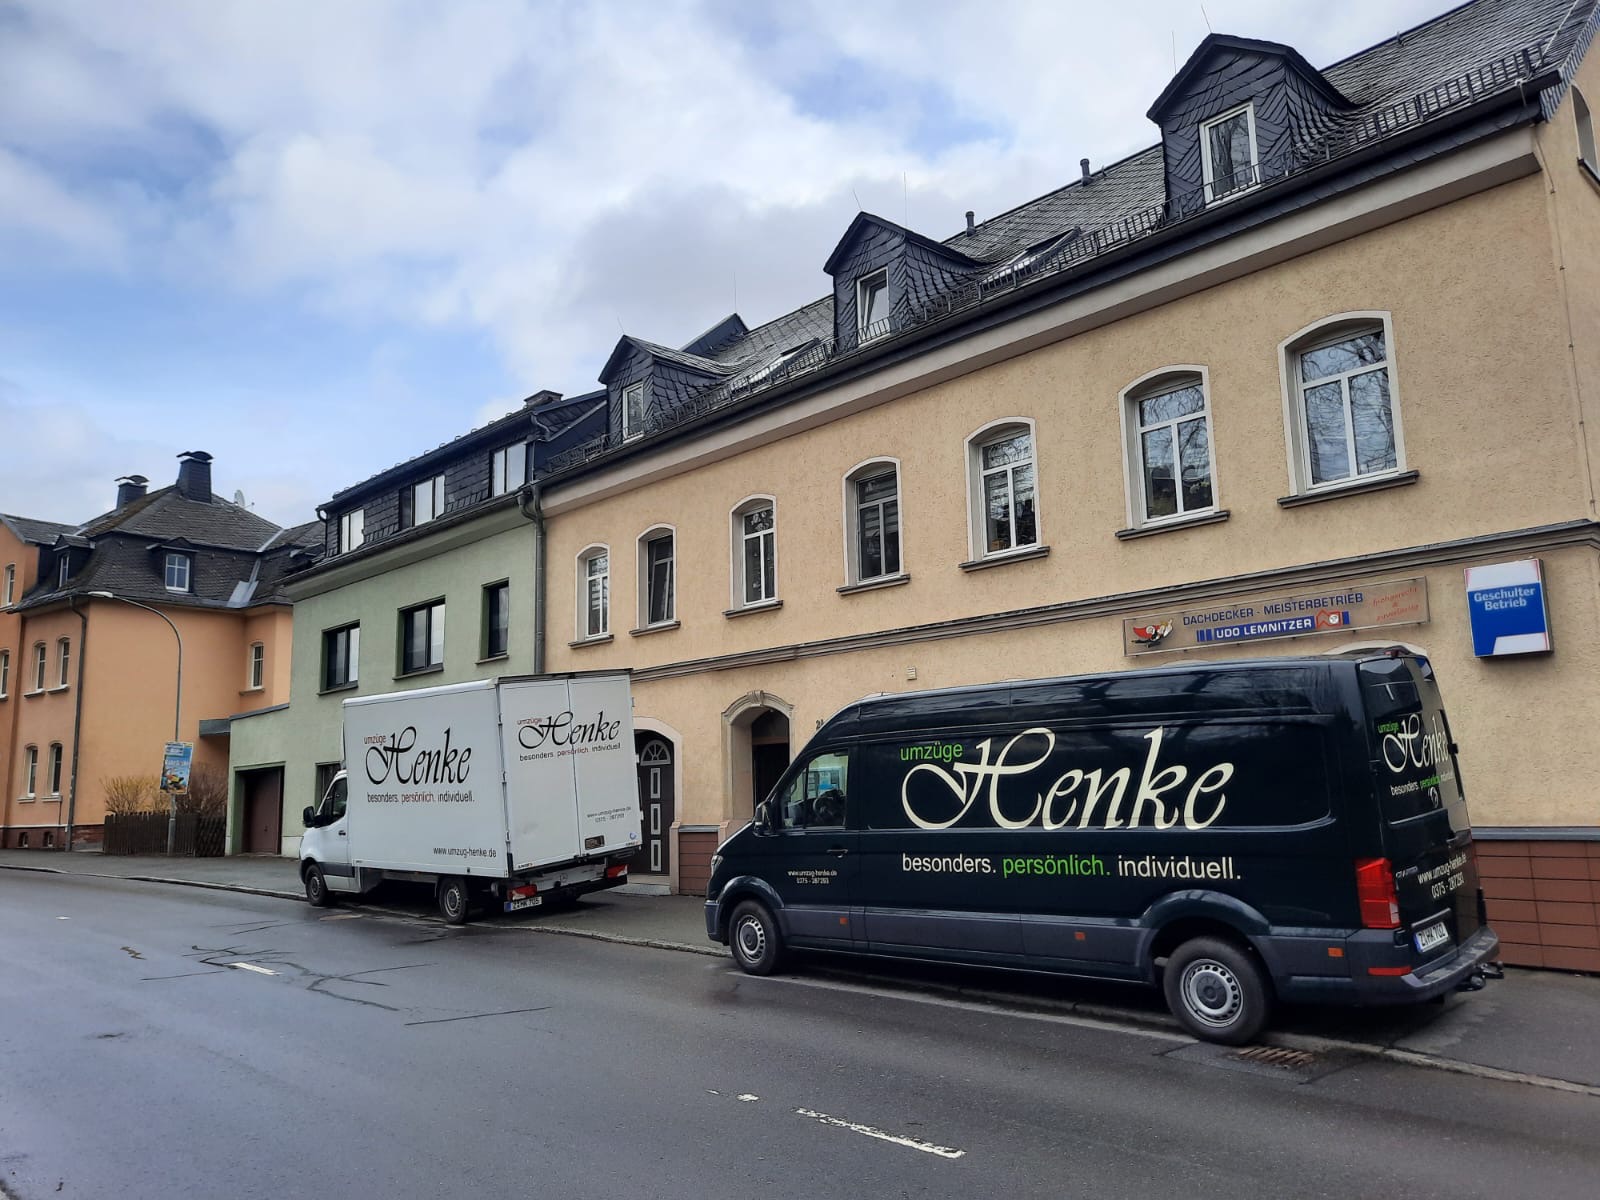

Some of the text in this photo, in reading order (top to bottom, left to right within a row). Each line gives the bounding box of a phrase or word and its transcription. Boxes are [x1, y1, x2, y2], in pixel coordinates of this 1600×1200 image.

[1474, 587, 1535, 602] Geschulter
[1484, 597, 1527, 611] Betrieb
[1183, 607, 1254, 626] DACHDECKER
[1263, 592, 1363, 615] MEISTERBETRIEB
[1216, 618, 1312, 639] UDO LEMNITZER
[363, 733, 387, 745] umzüge
[518, 710, 621, 749] Henke
[365, 726, 472, 785] Henke
[900, 740, 963, 762] umzüge
[902, 725, 1235, 830] Henke
[433, 847, 497, 858] www.umzug-henke.de
[902, 853, 1242, 880] besonders. persönlich. individuell.
[1431, 880, 1446, 899] 0375
